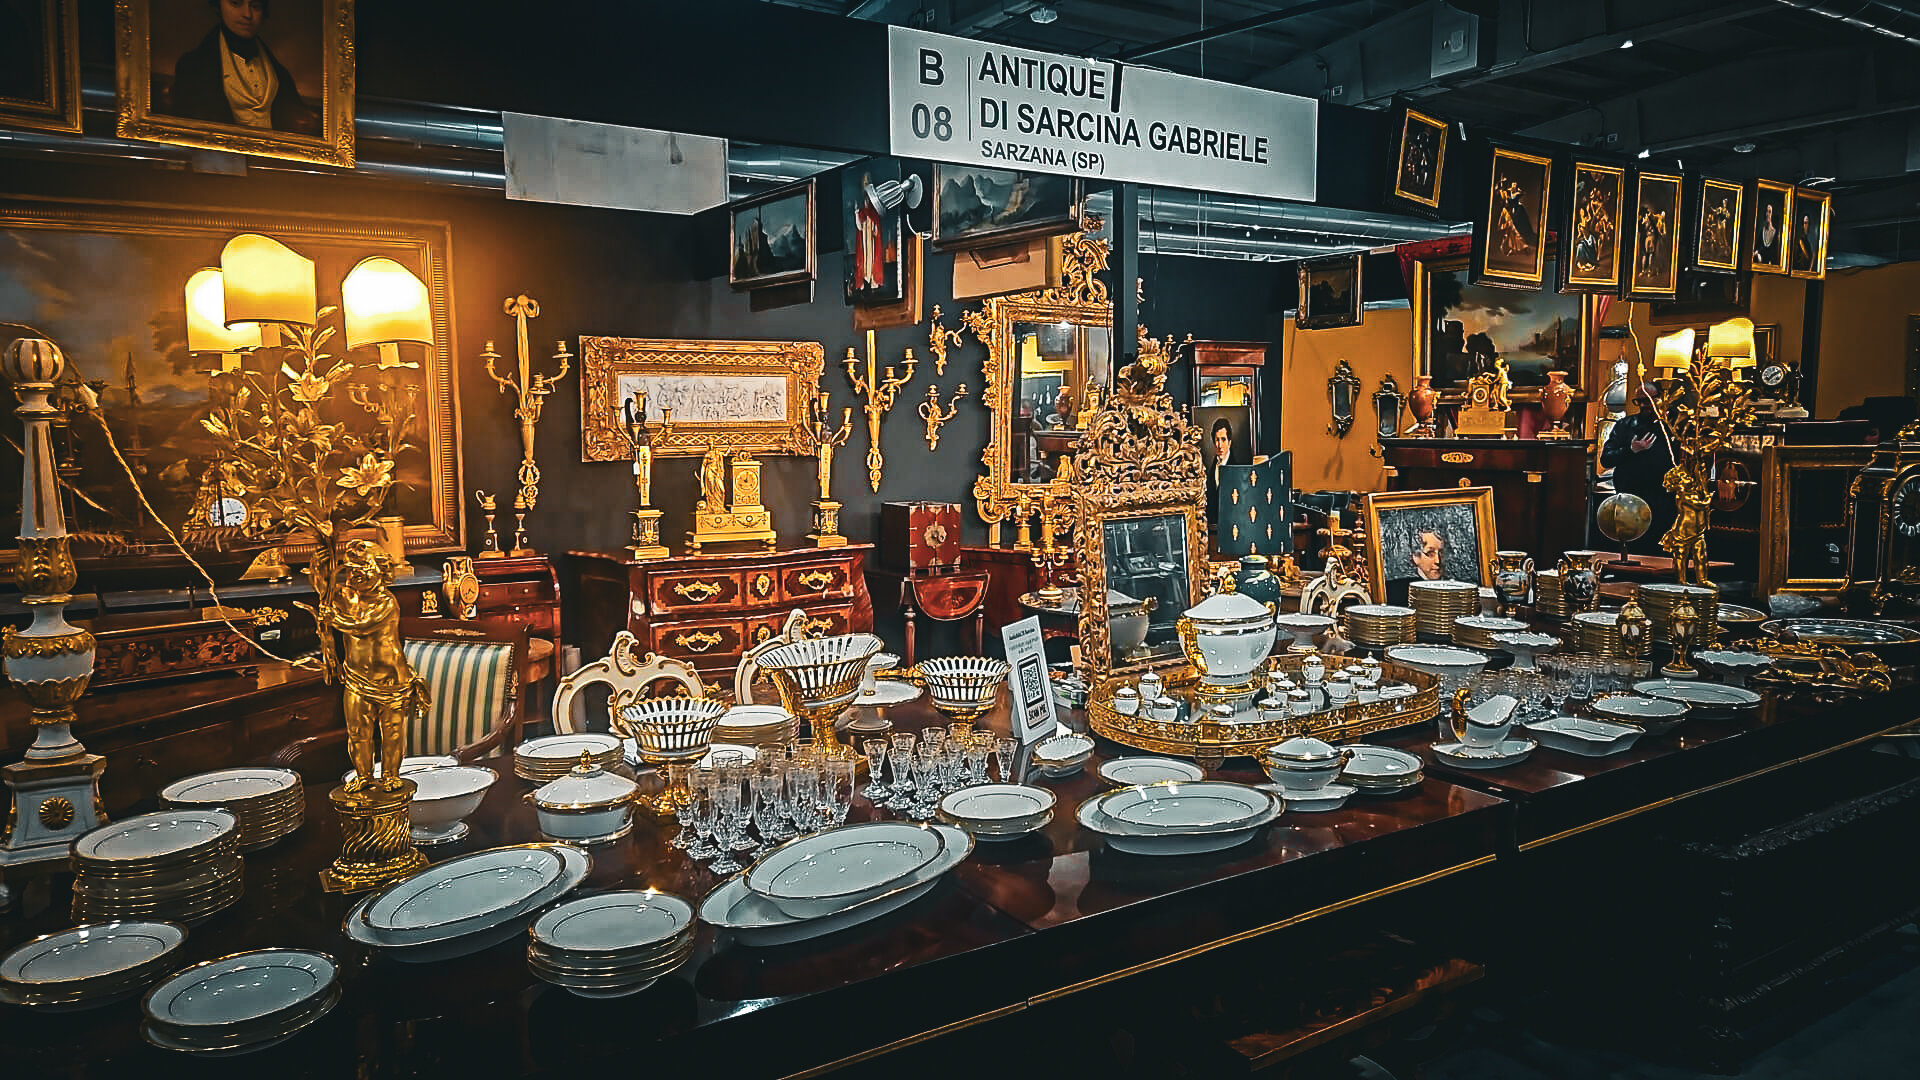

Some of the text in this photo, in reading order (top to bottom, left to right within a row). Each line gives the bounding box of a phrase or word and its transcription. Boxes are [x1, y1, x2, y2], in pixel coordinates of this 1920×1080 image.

[919, 47, 945, 86] B
[978, 51, 1106, 100] ANTIQUE
[911, 103, 953, 142] 08
[980, 97, 1268, 165] DI SARCINA GABRIELE
[981, 139, 1105, 176] SARZANA (SP)
